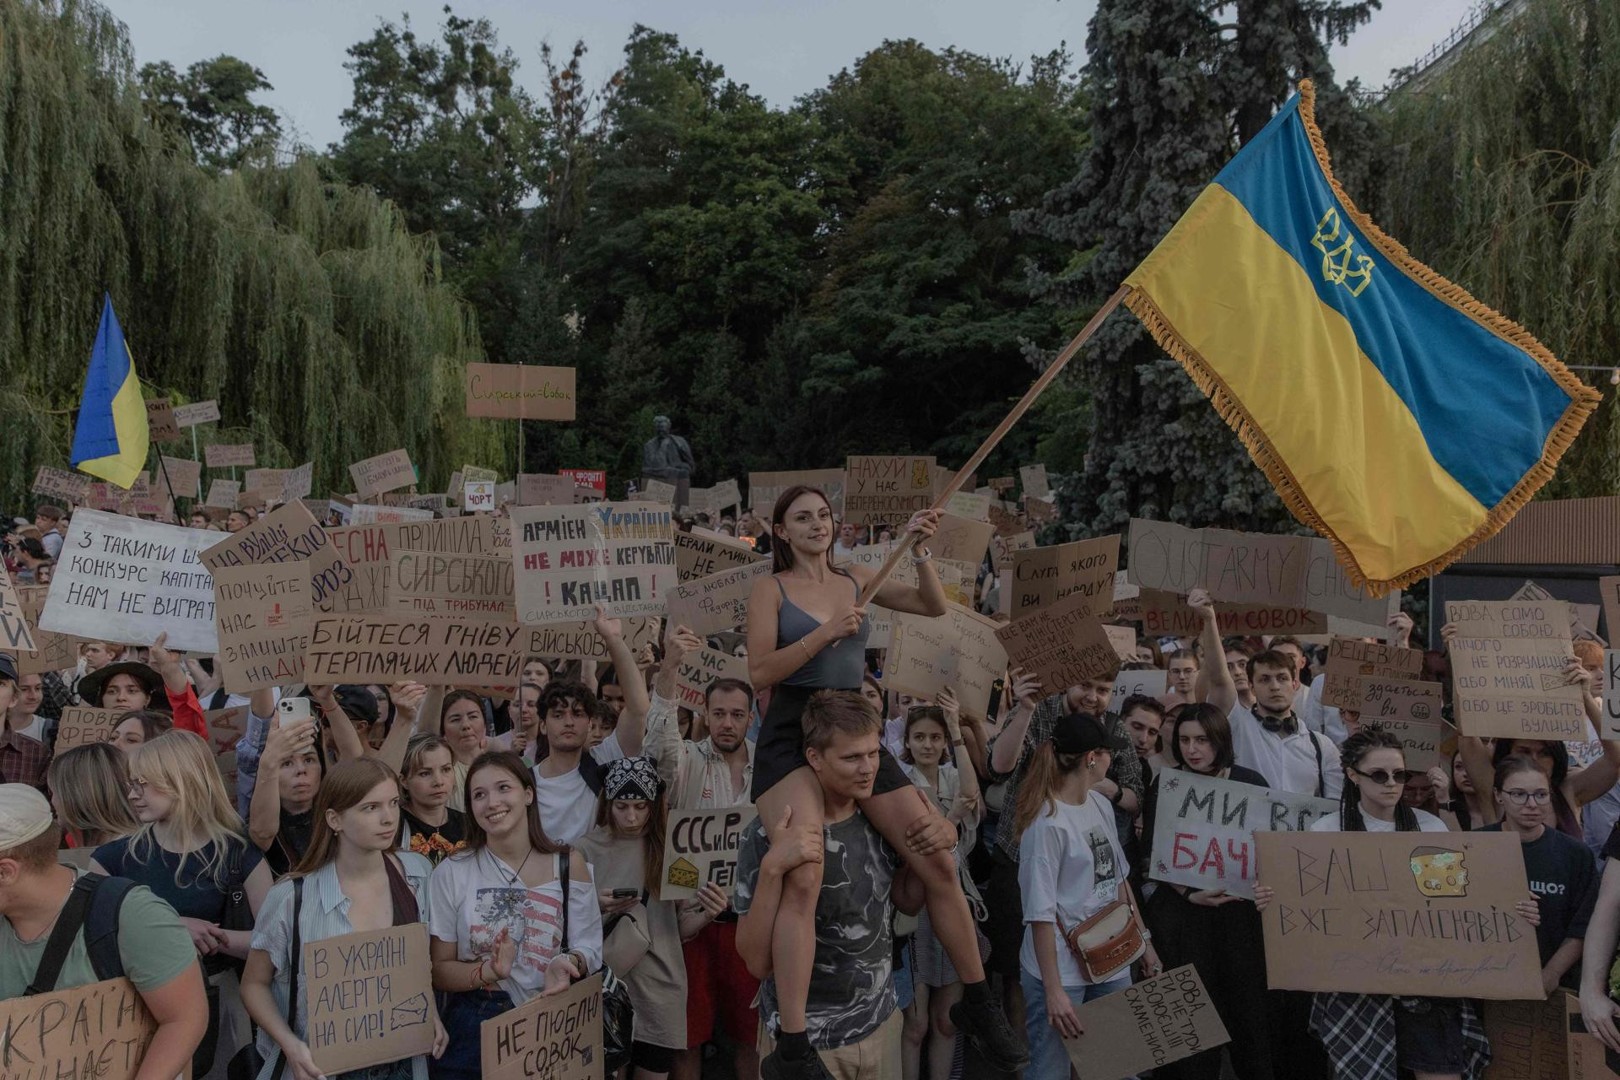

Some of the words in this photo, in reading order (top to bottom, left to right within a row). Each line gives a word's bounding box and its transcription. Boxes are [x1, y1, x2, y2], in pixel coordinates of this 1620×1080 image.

[849, 457, 907, 479] НАХУЙ
[469, 494, 492, 504] ЧОРТ
[876, 480, 899, 492] НАС
[596, 507, 672, 540] УКРАЇНИ
[78, 531, 92, 549] З
[103, 534, 175, 563] ТАКИМИ
[524, 551, 551, 570] НЕ
[560, 548, 610, 569] МОЖЕ
[617, 542, 675, 566] КЕРУВАТИ
[70, 555, 148, 583] КОНКУРС
[693, 556, 716, 574] НЕ
[1217, 545, 1296, 595] ARMY
[65, 582, 109, 610] НАМ
[118, 591, 146, 614] НЕ
[414, 599, 435, 612] ПІД
[561, 576, 641, 607] КАЦАП
[1021, 594, 1040, 608] ВИ
[220, 614, 256, 634] НАС
[1245, 609, 1318, 628] СОВОК
[1450, 605, 1496, 622] ВОВА
[312, 617, 430, 645] БІЙТЕСЯ
[445, 622, 520, 647] ГНІВУ
[1000, 626, 1018, 641] ЦЕ
[1453, 640, 1502, 653] НІЧОГО
[311, 650, 440, 675] ТЕРПЛЯЧИХ
[444, 648, 521, 678] ЛЮДЕЙ
[700, 651, 727, 672] ЧАС
[1472, 656, 1489, 669] НЕ
[1494, 673, 1535, 690] МІНЯЙ
[1496, 701, 1516, 715] ЦЕ
[1521, 700, 1583, 716] ЗРОБИТЬ
[1521, 718, 1581, 735] ВУЛИЦЯ
[1178, 785, 1249, 831] МИ
[1173, 831, 1258, 881] БАЧ
[1292, 846, 1389, 897] ВАШ
[1279, 903, 1342, 937] ВЖЕ
[1360, 900, 1523, 944] ЗАПЛІСНЯВІВ
[314, 948, 329, 979] В
[338, 935, 406, 977] УКРАЇНІ
[314, 973, 391, 1017] АЛЕРГІЯ
[1169, 998, 1188, 1020] НЕ
[315, 1020, 336, 1049] НА
[345, 1009, 384, 1043] СИР!
[497, 1017, 529, 1065] НЕ
[536, 991, 599, 1042] ЛЮБЛЮ
[523, 1032, 585, 1077] СОВОК
